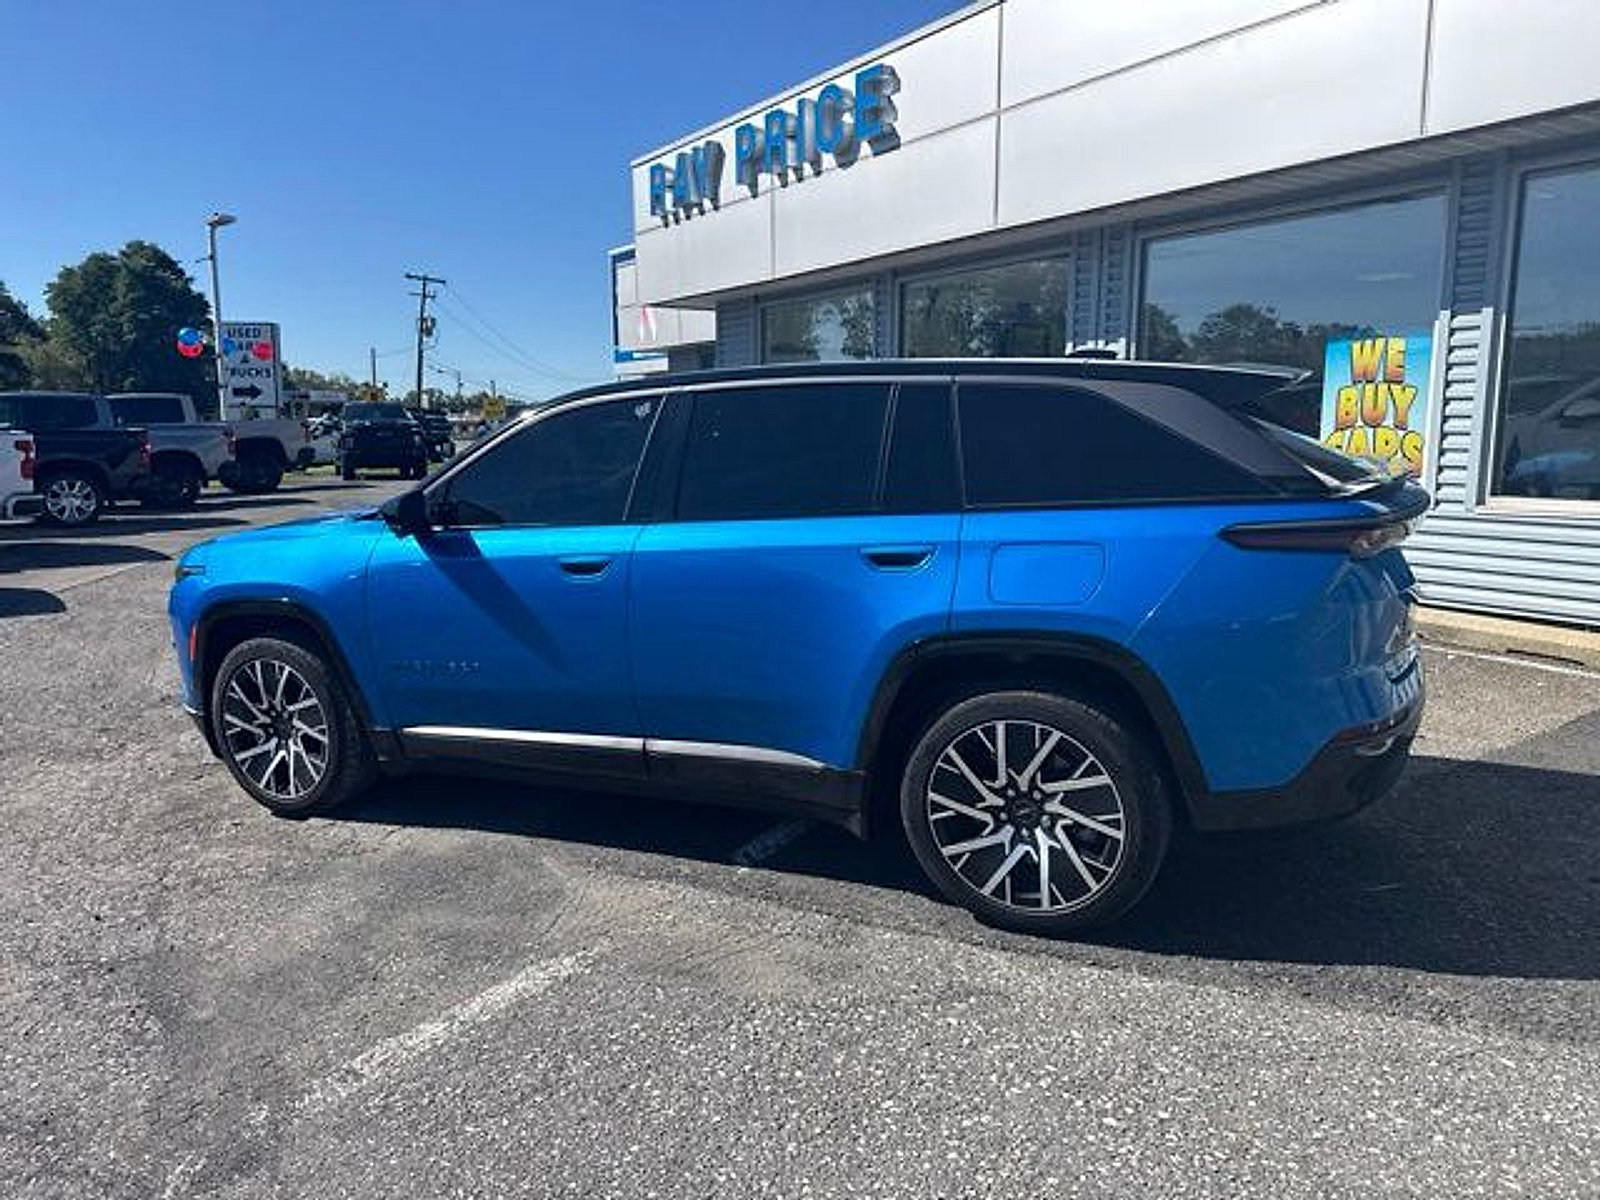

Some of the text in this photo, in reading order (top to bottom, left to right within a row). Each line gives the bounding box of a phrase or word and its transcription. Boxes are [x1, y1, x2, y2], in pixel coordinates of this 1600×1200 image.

[649, 62, 898, 224] RAY PRICE
[227, 326, 262, 339] USED
[225, 366, 272, 379] TRUCKS
[1351, 336, 1406, 384] WE
[1334, 381, 1418, 430] BUY
